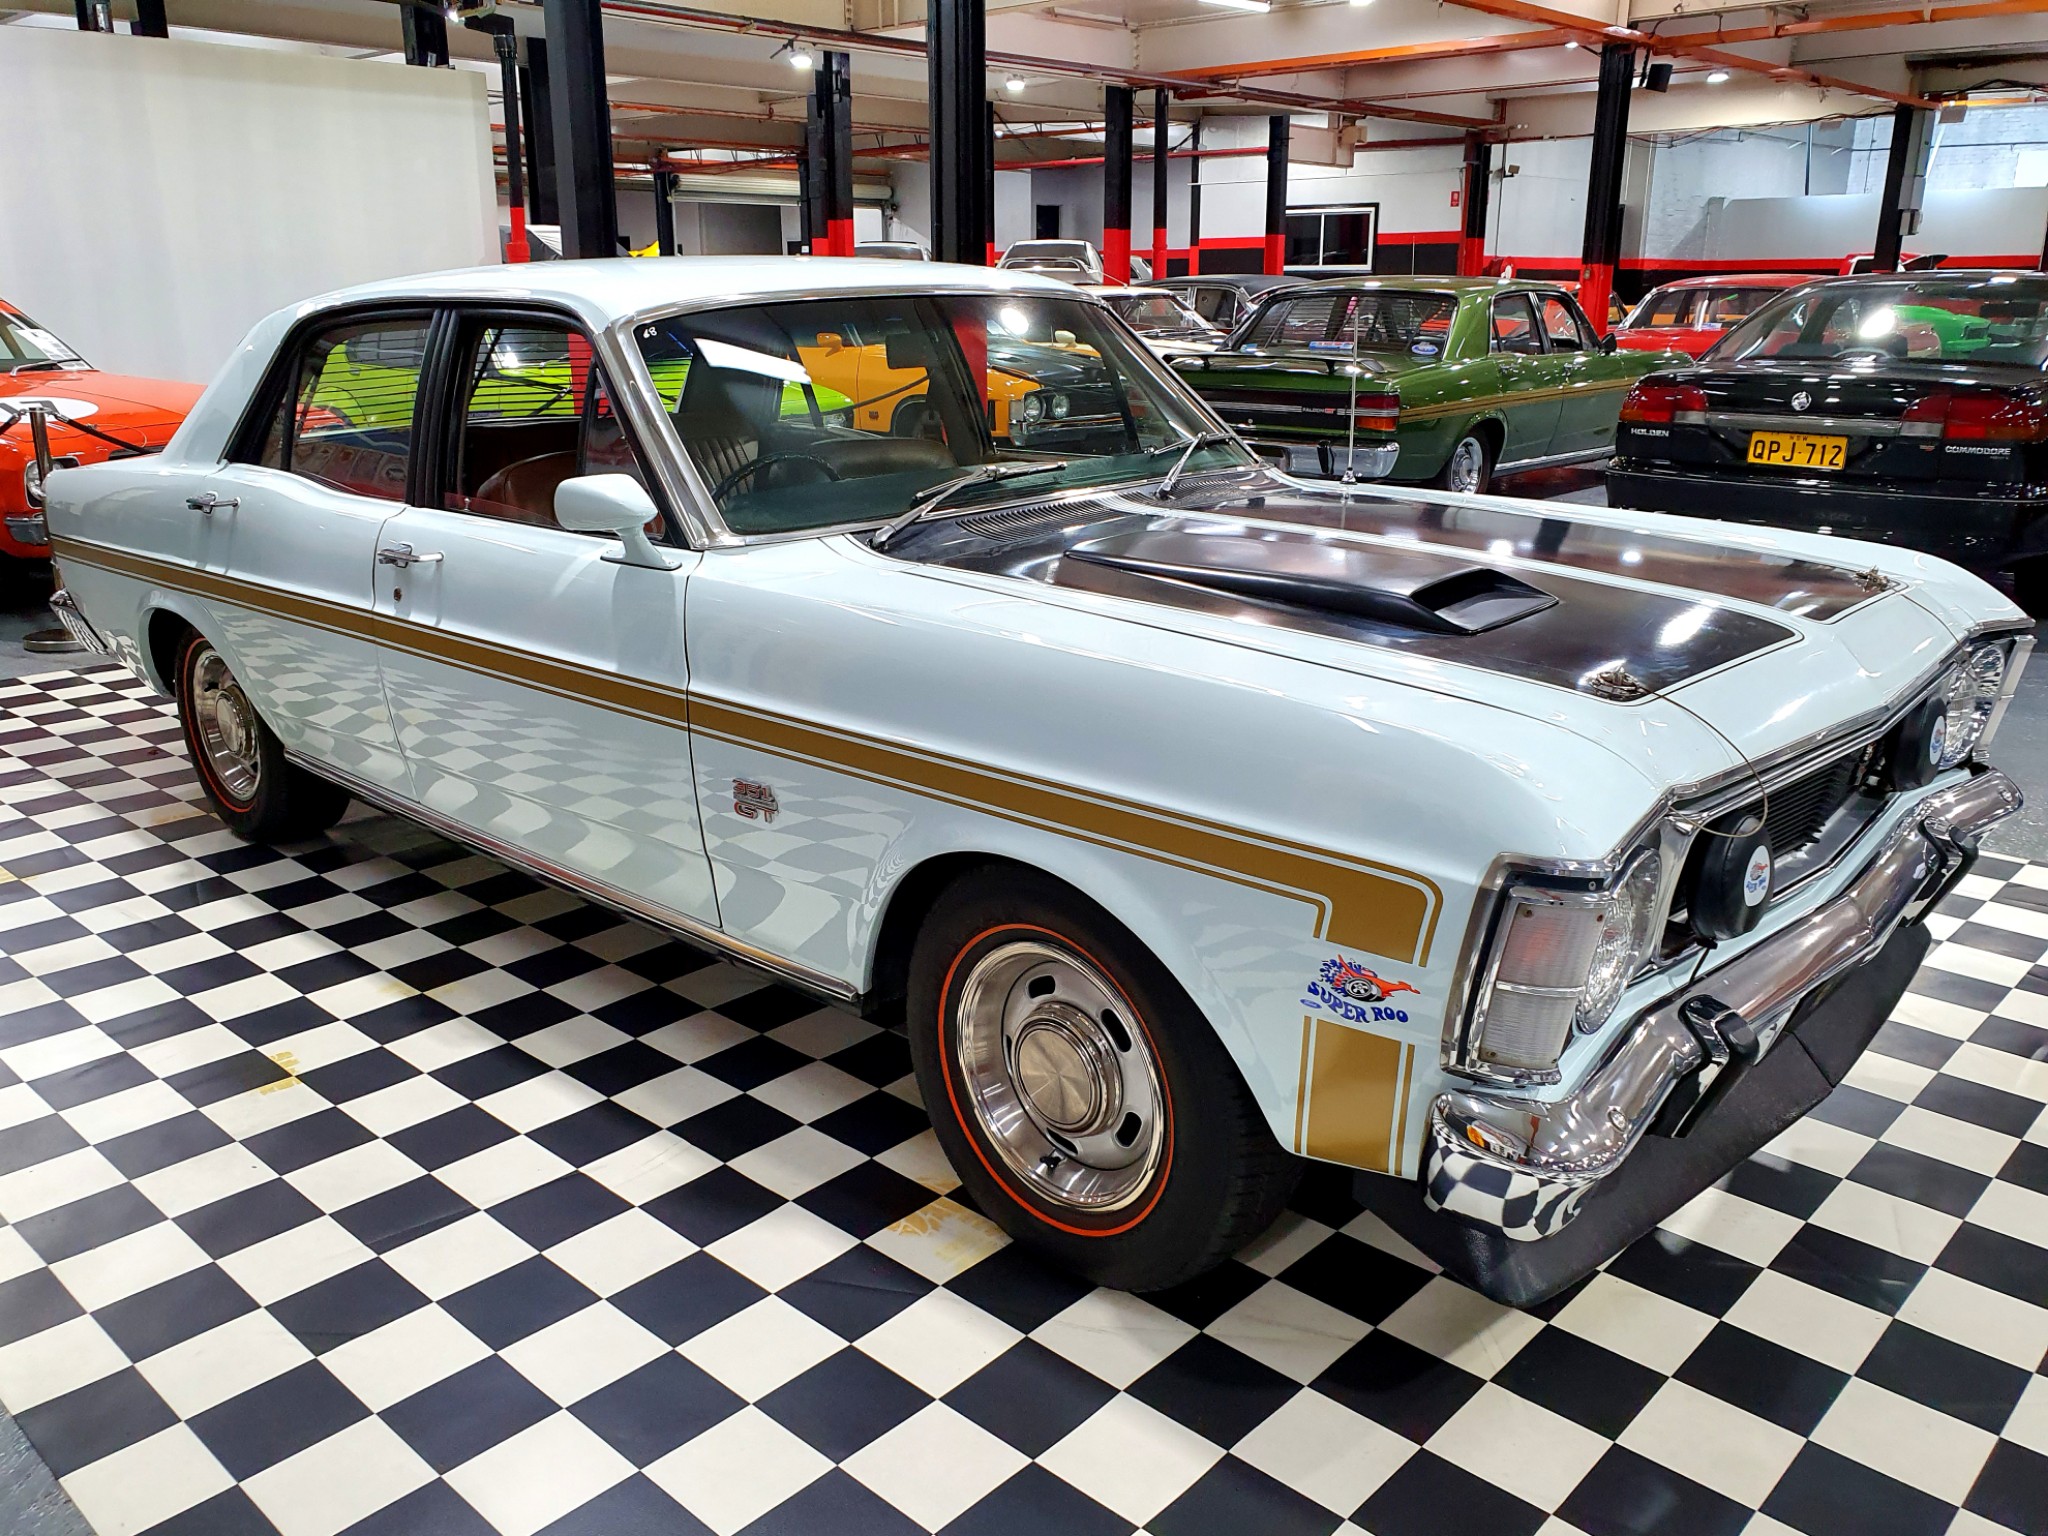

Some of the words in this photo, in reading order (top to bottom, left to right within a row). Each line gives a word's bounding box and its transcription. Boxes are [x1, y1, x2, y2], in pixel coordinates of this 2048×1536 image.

[1631, 428, 1669, 437] HOLDEN
[1945, 445, 2011, 455] COMMODORE
[1307, 981, 1370, 1023] SUPER
[1371, 1006, 1409, 1023] ROO
